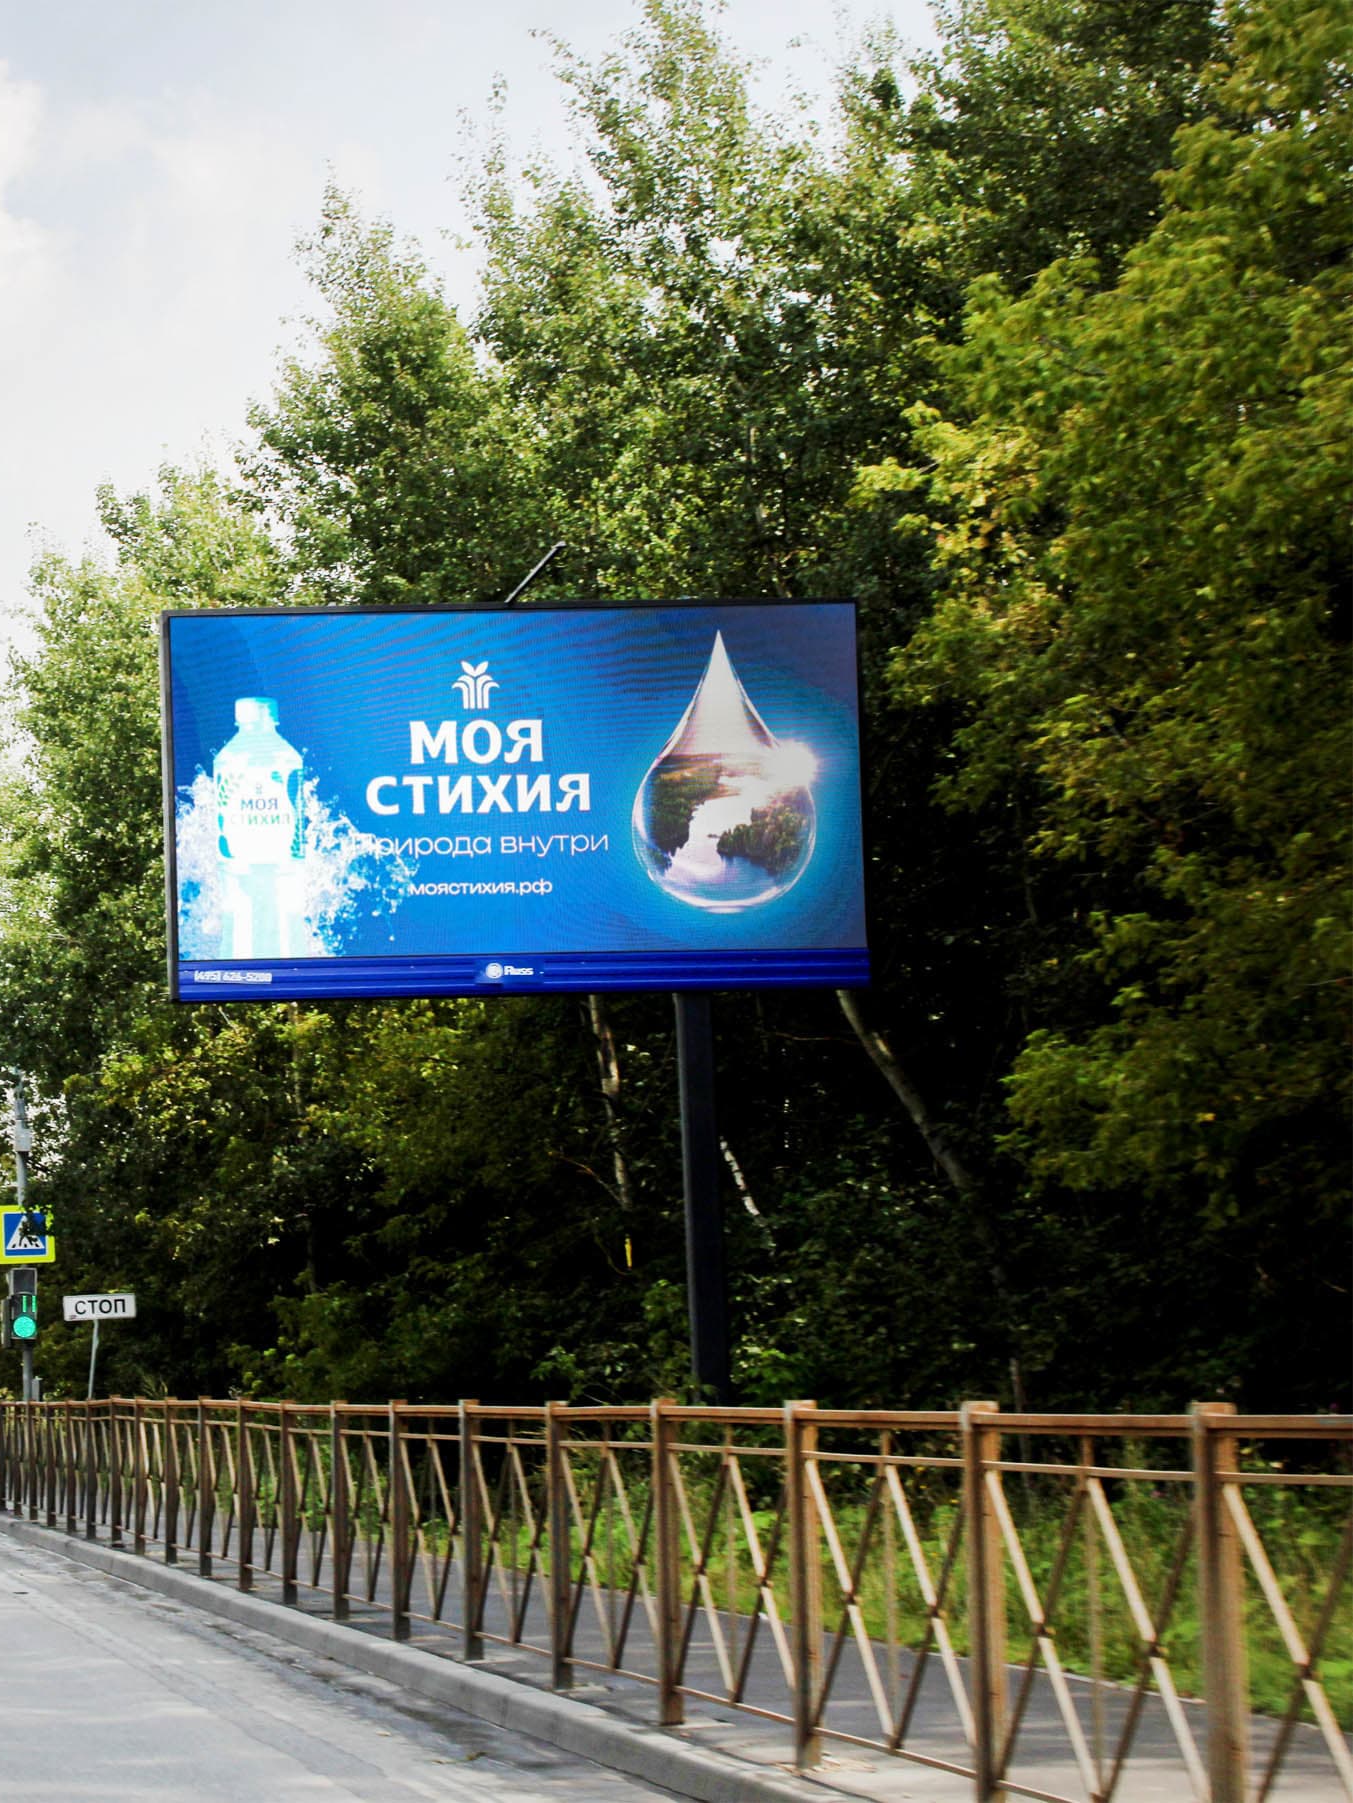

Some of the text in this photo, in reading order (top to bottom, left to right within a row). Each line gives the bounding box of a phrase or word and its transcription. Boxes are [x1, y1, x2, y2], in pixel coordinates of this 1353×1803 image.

[410, 719, 544, 765] МОЯ
[240, 798, 279, 811] МОЯ
[365, 773, 591, 816] СТИХИЯ
[500, 834, 610, 857] внутри
[408, 878, 553, 896] моястихия.рф
[74, 1298, 126, 1315] СТОП
